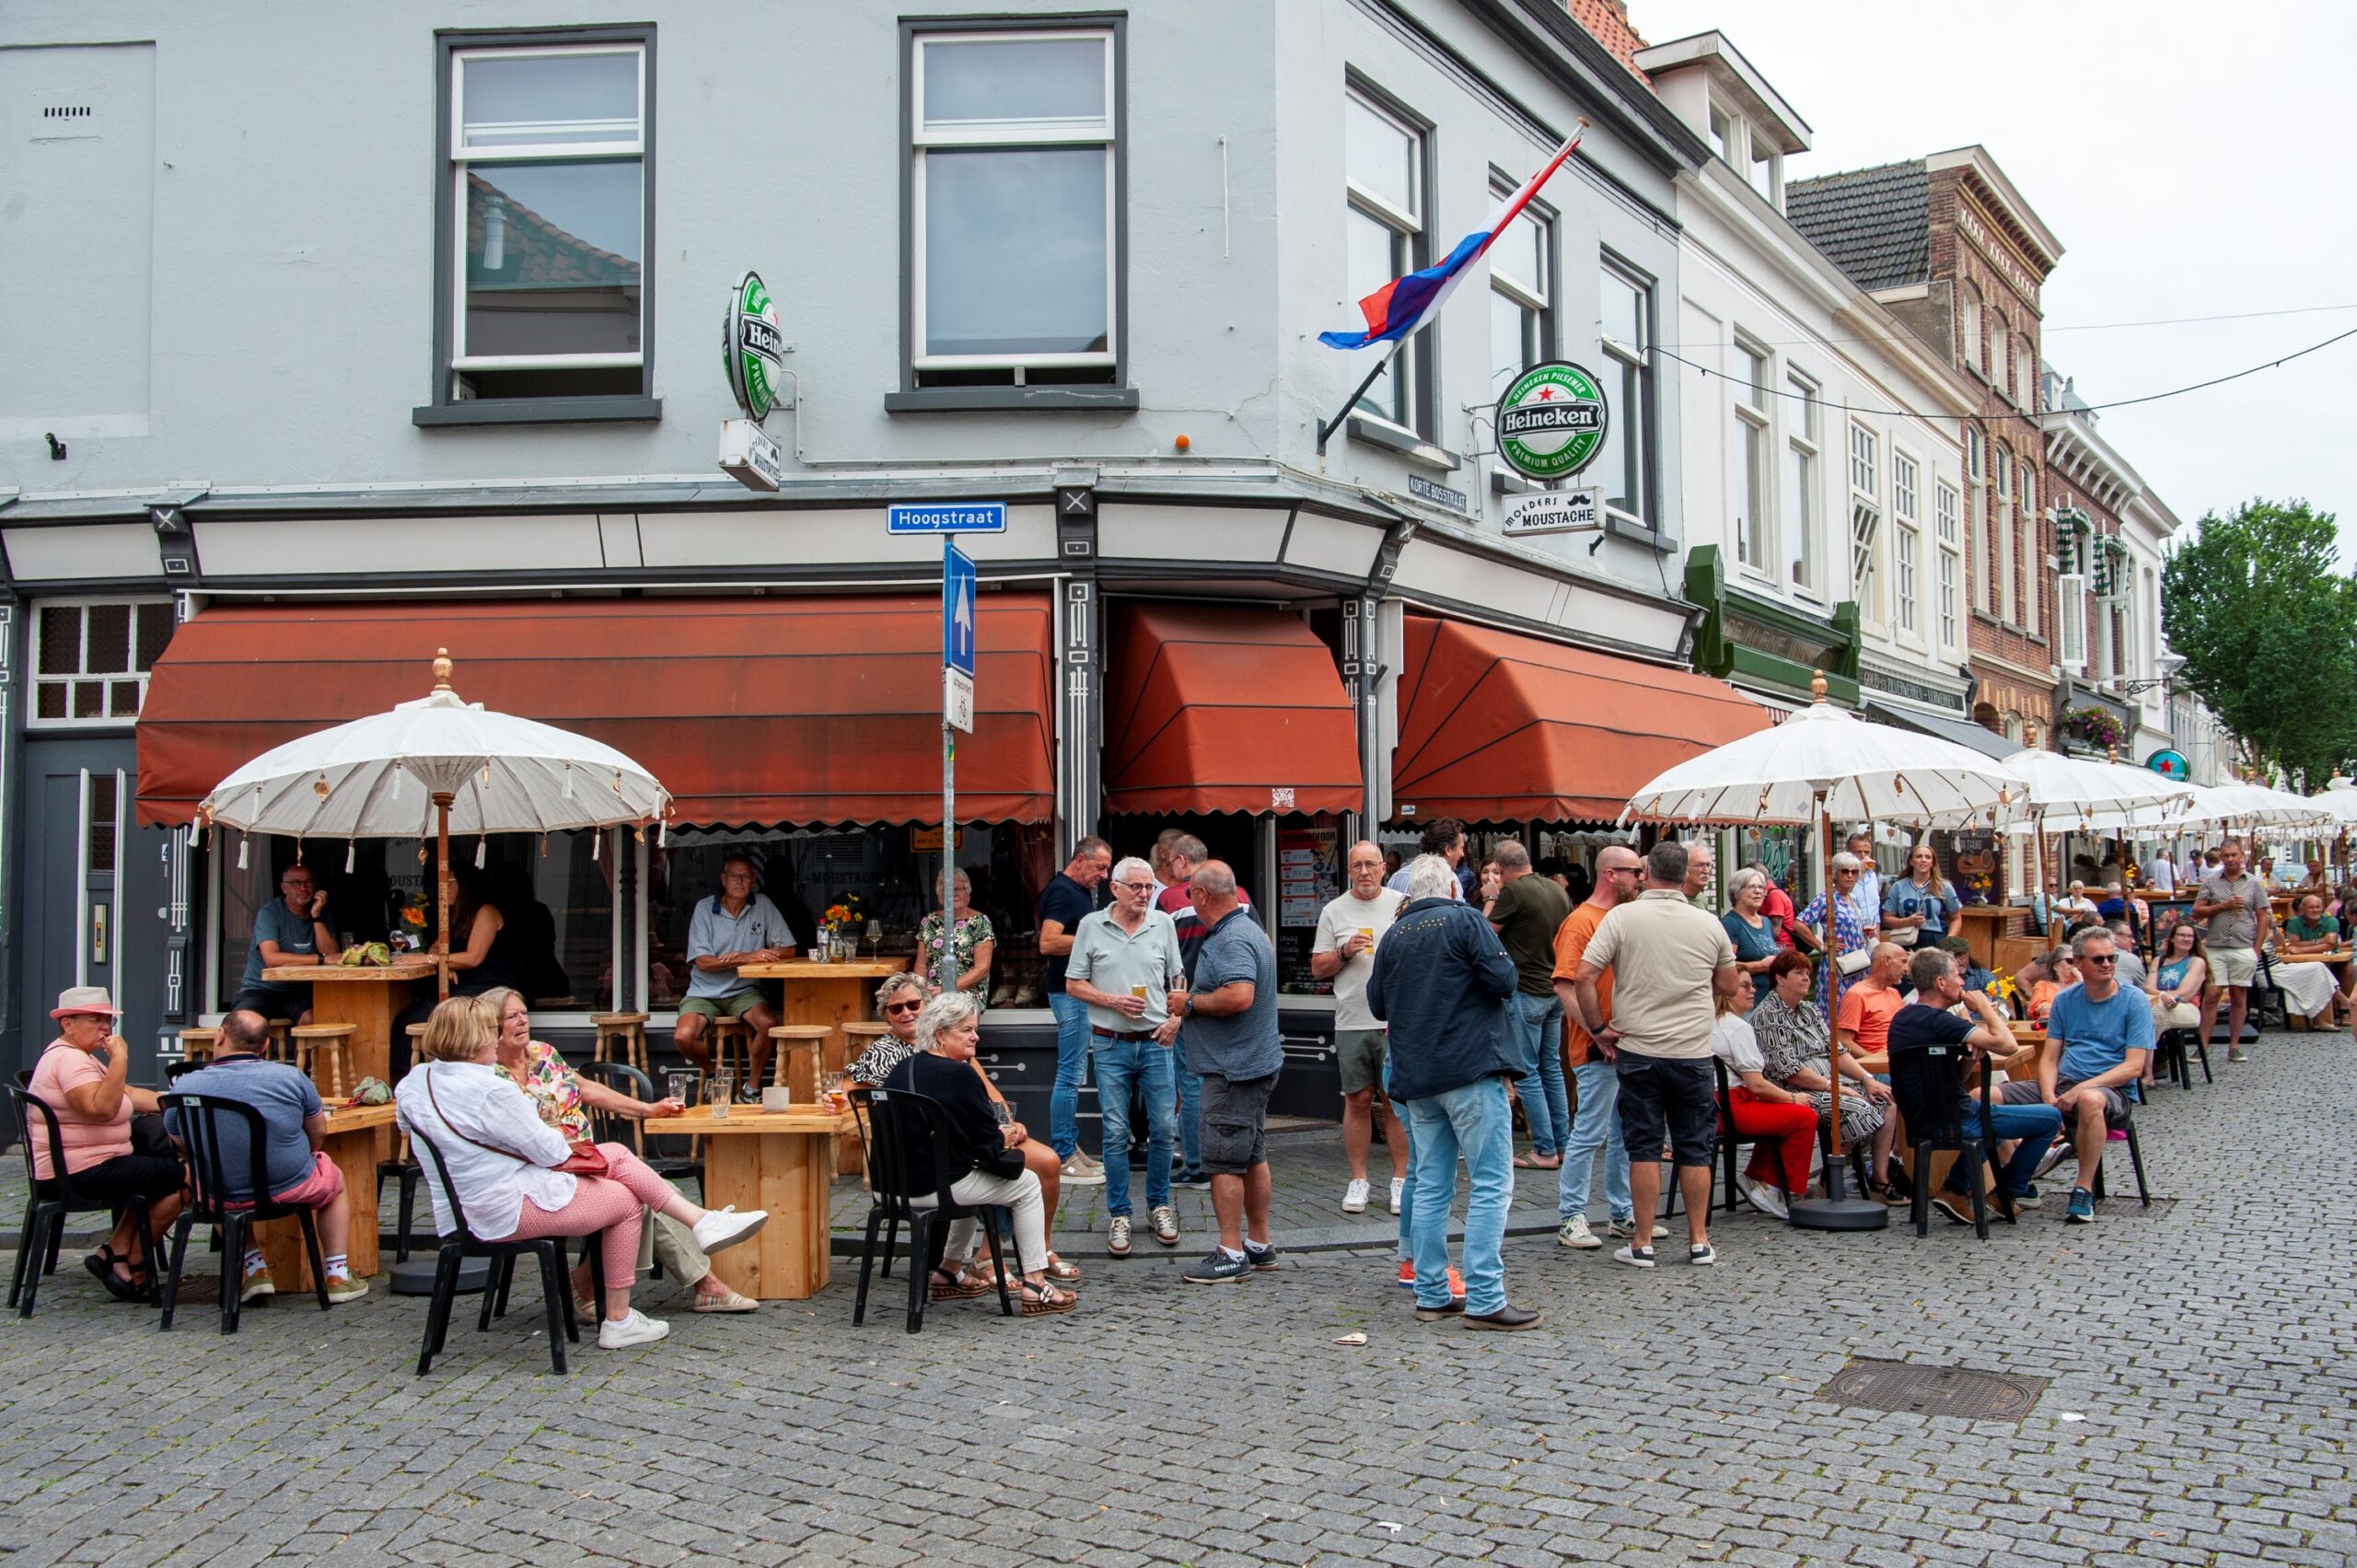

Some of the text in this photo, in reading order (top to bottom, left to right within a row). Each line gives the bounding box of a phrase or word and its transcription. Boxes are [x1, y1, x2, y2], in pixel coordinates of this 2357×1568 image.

[1513, 372, 1586, 401] HEINEKEN PILSENER
[1505, 407, 1594, 432] Heineken
[1511, 444, 1549, 468] PREMIUM
[1551, 438, 1586, 466] QUALITY
[1410, 477, 1466, 509] KORTE BOSSTRAAT
[899, 510, 993, 528] Hoogstraat
[1505, 497, 1558, 527] MOEDERS
[1522, 508, 1595, 527] MOUSTACHE
